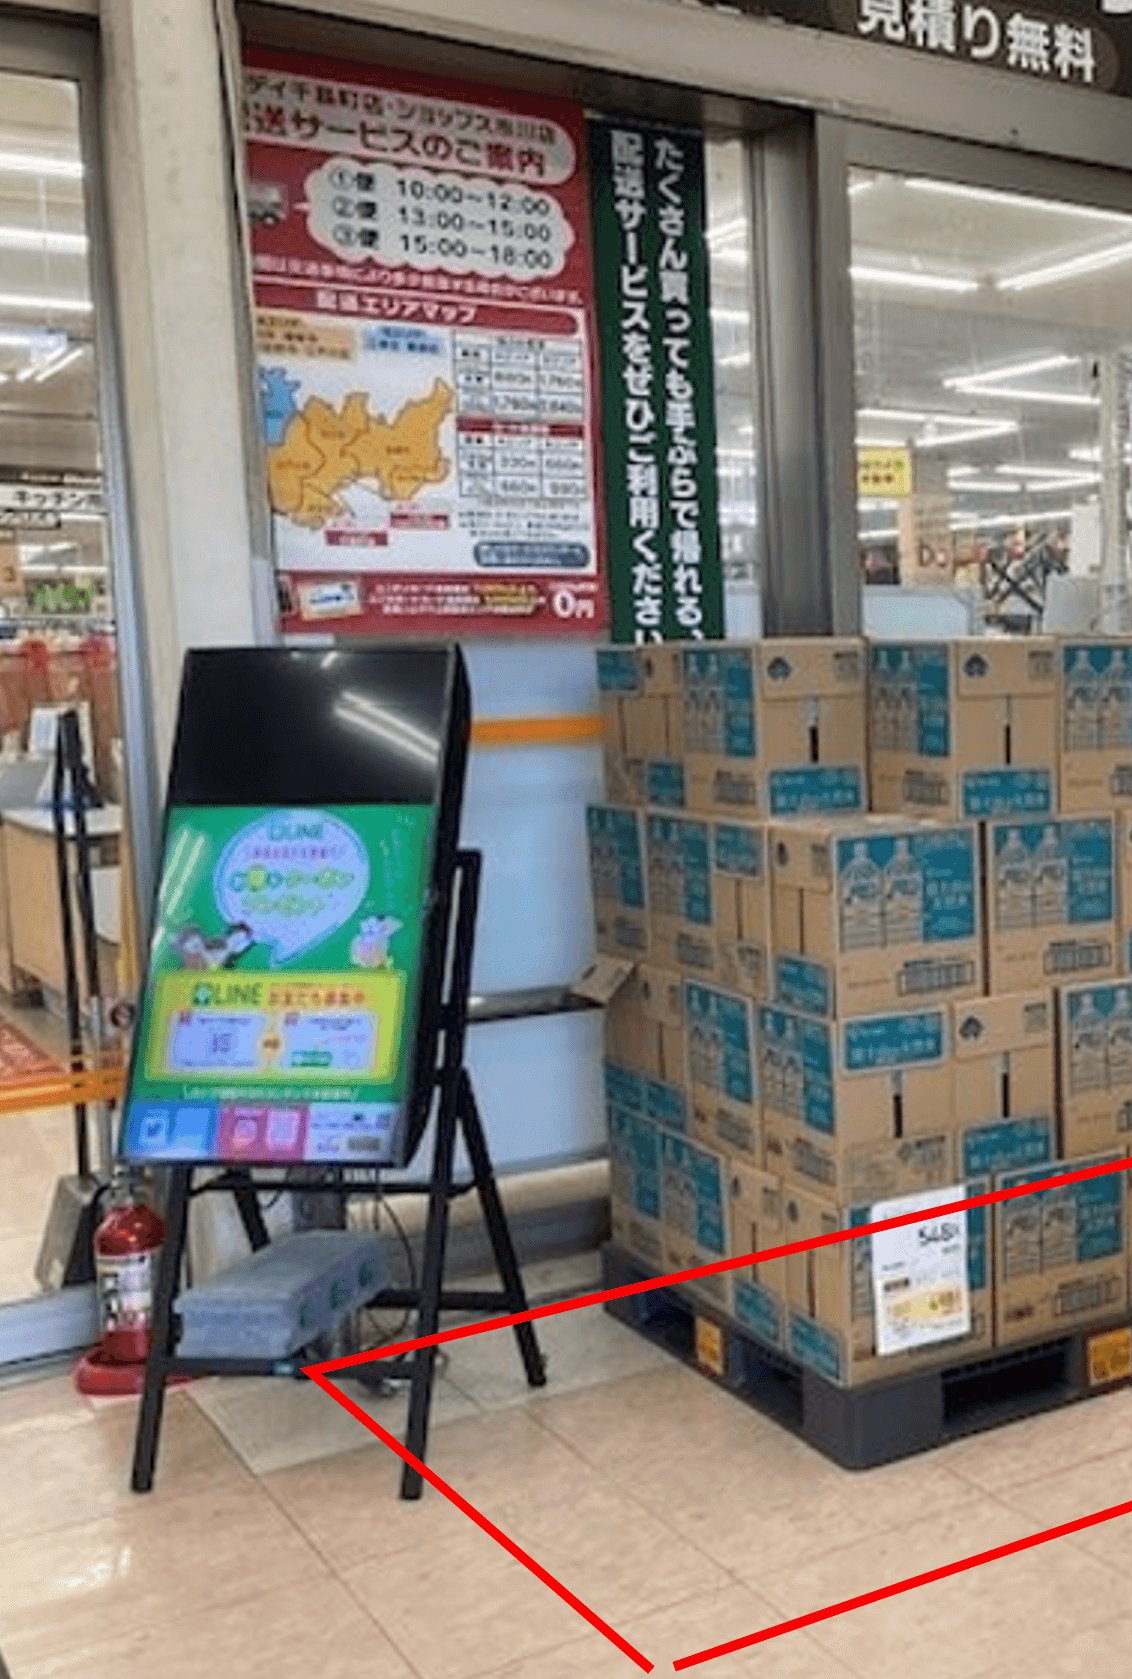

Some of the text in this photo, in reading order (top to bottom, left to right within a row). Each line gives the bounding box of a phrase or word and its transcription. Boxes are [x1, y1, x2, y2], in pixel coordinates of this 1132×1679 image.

[857, 0, 1094, 82] 見積り無料
